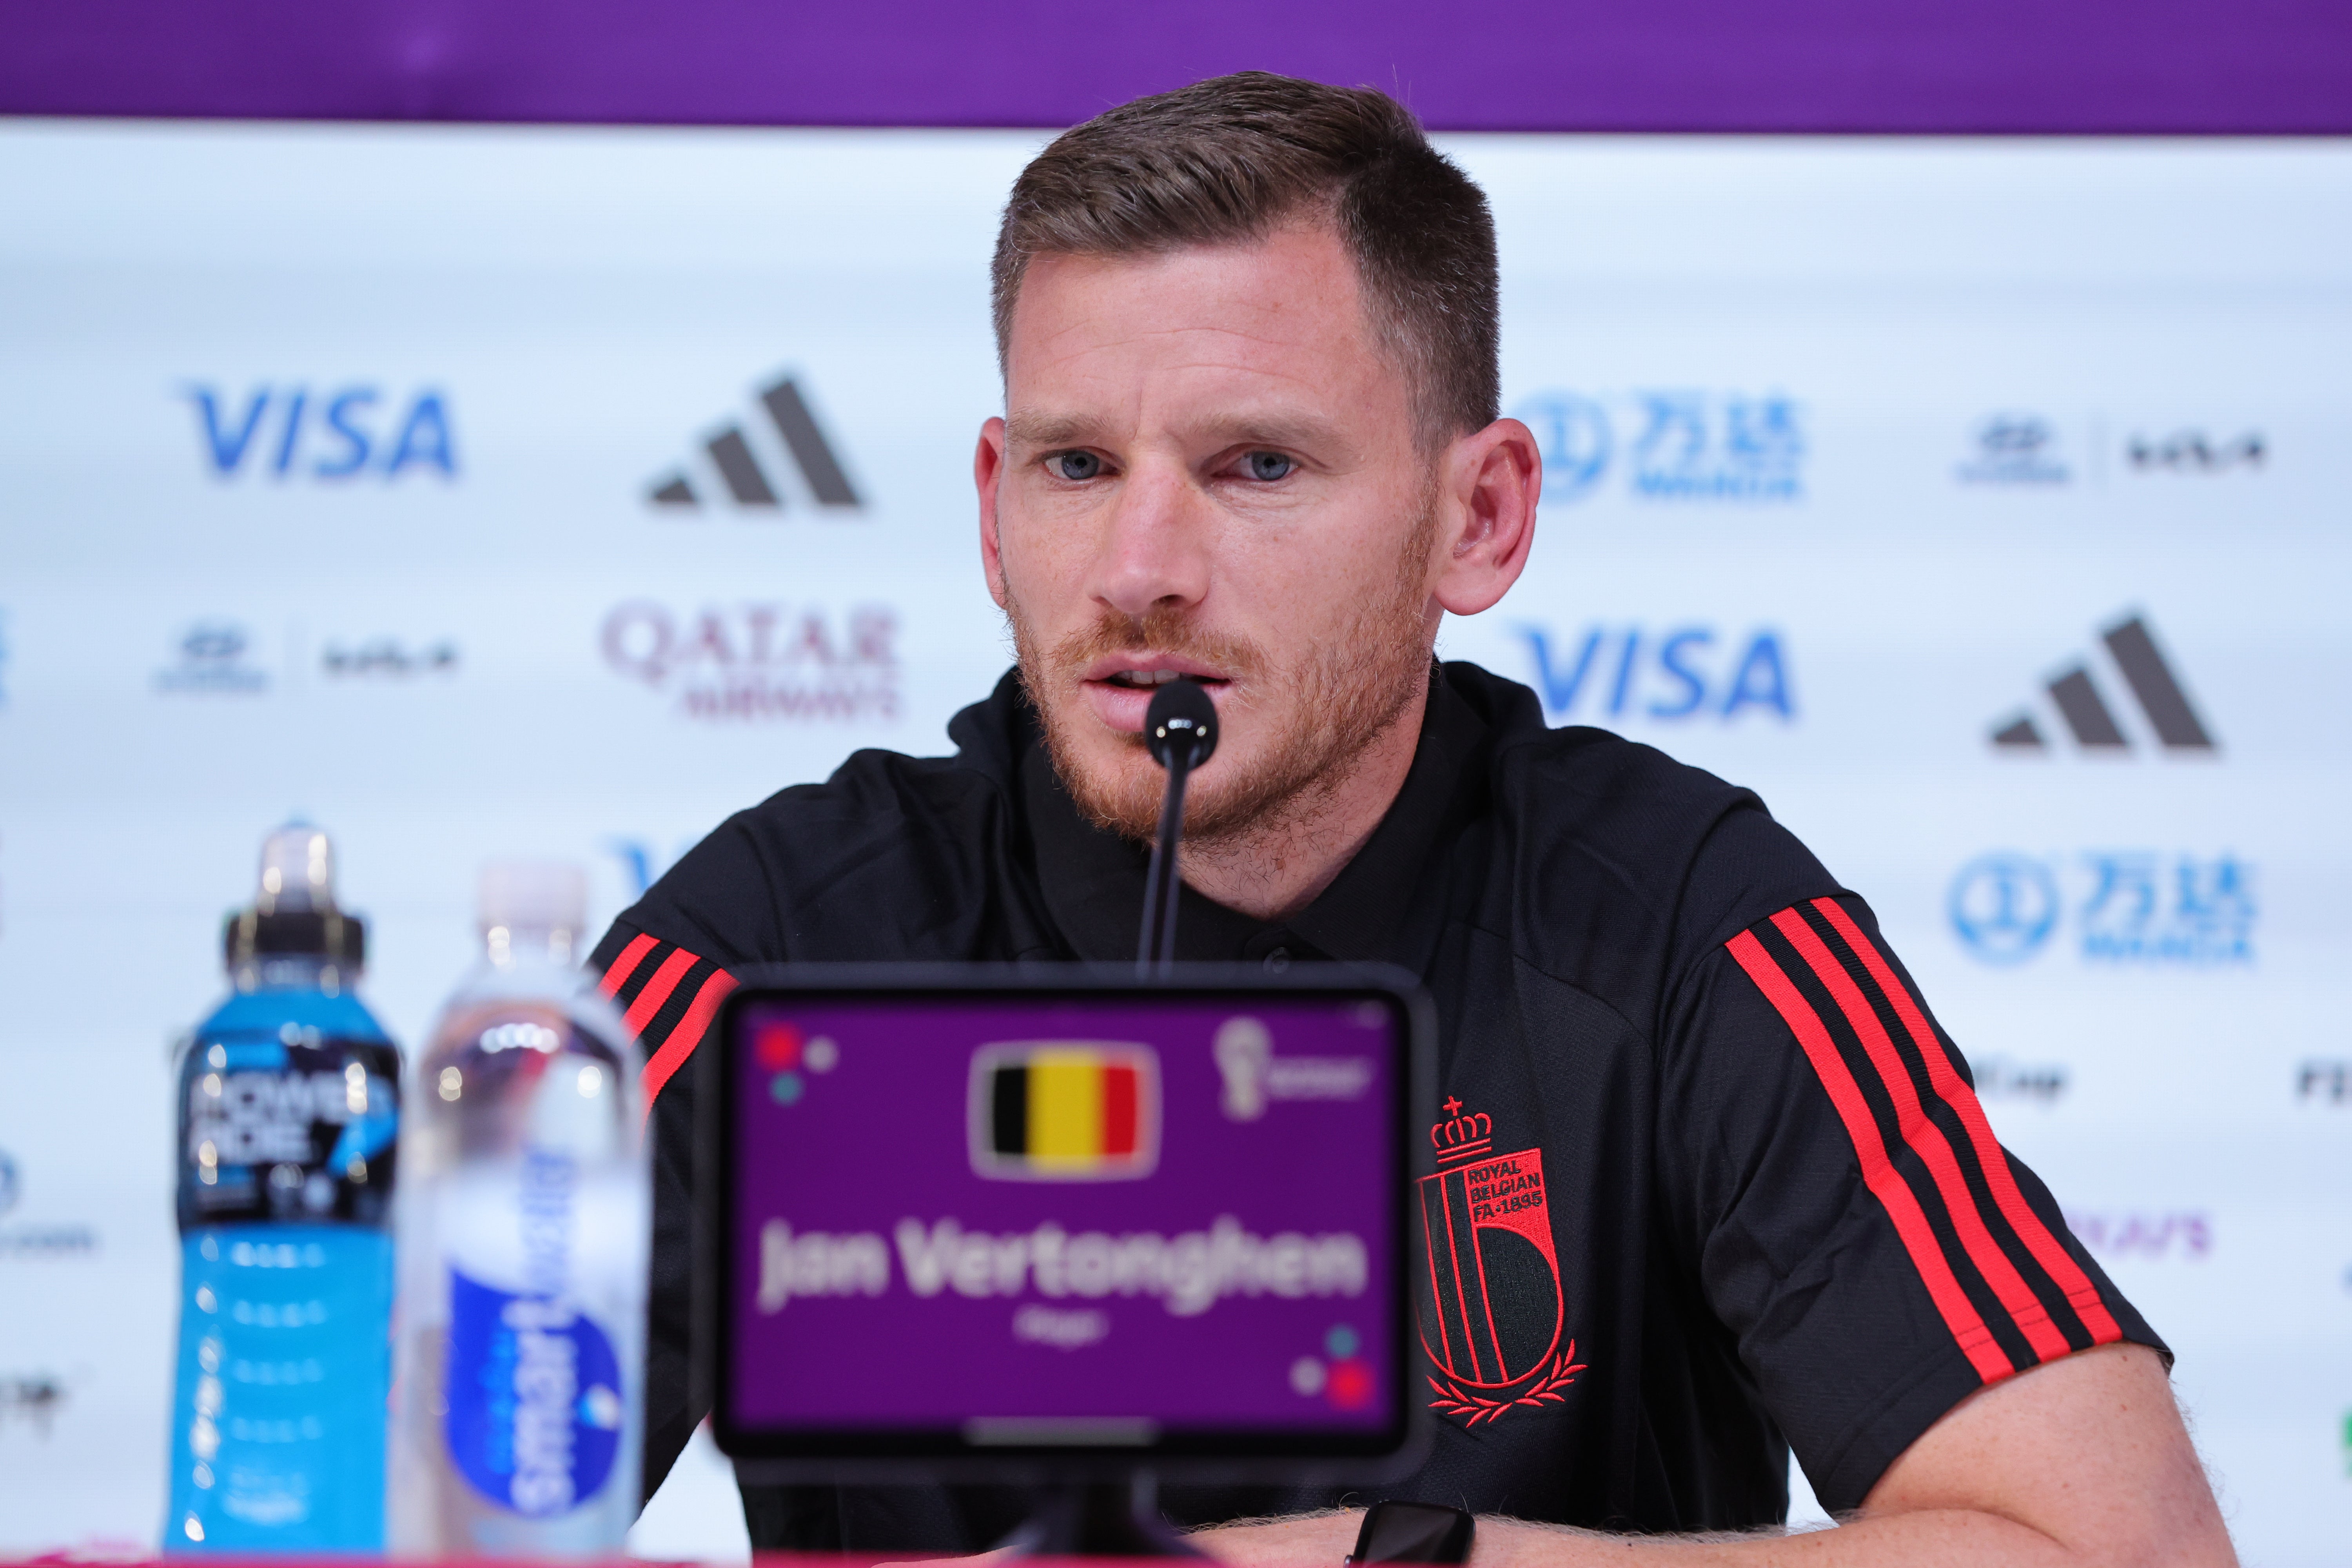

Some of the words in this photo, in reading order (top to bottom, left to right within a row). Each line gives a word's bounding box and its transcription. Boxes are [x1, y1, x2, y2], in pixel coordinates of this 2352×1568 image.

[176, 383, 459, 480] VISA
[598, 600, 902, 685] QATAR
[1507, 621, 1799, 722] VISA
[1469, 1160, 1521, 1184] ROYAL
[1471, 1173, 1540, 1203] BELGIAN
[759, 1217, 890, 1312] Jan
[897, 1215, 1368, 1314] Vertonghen
